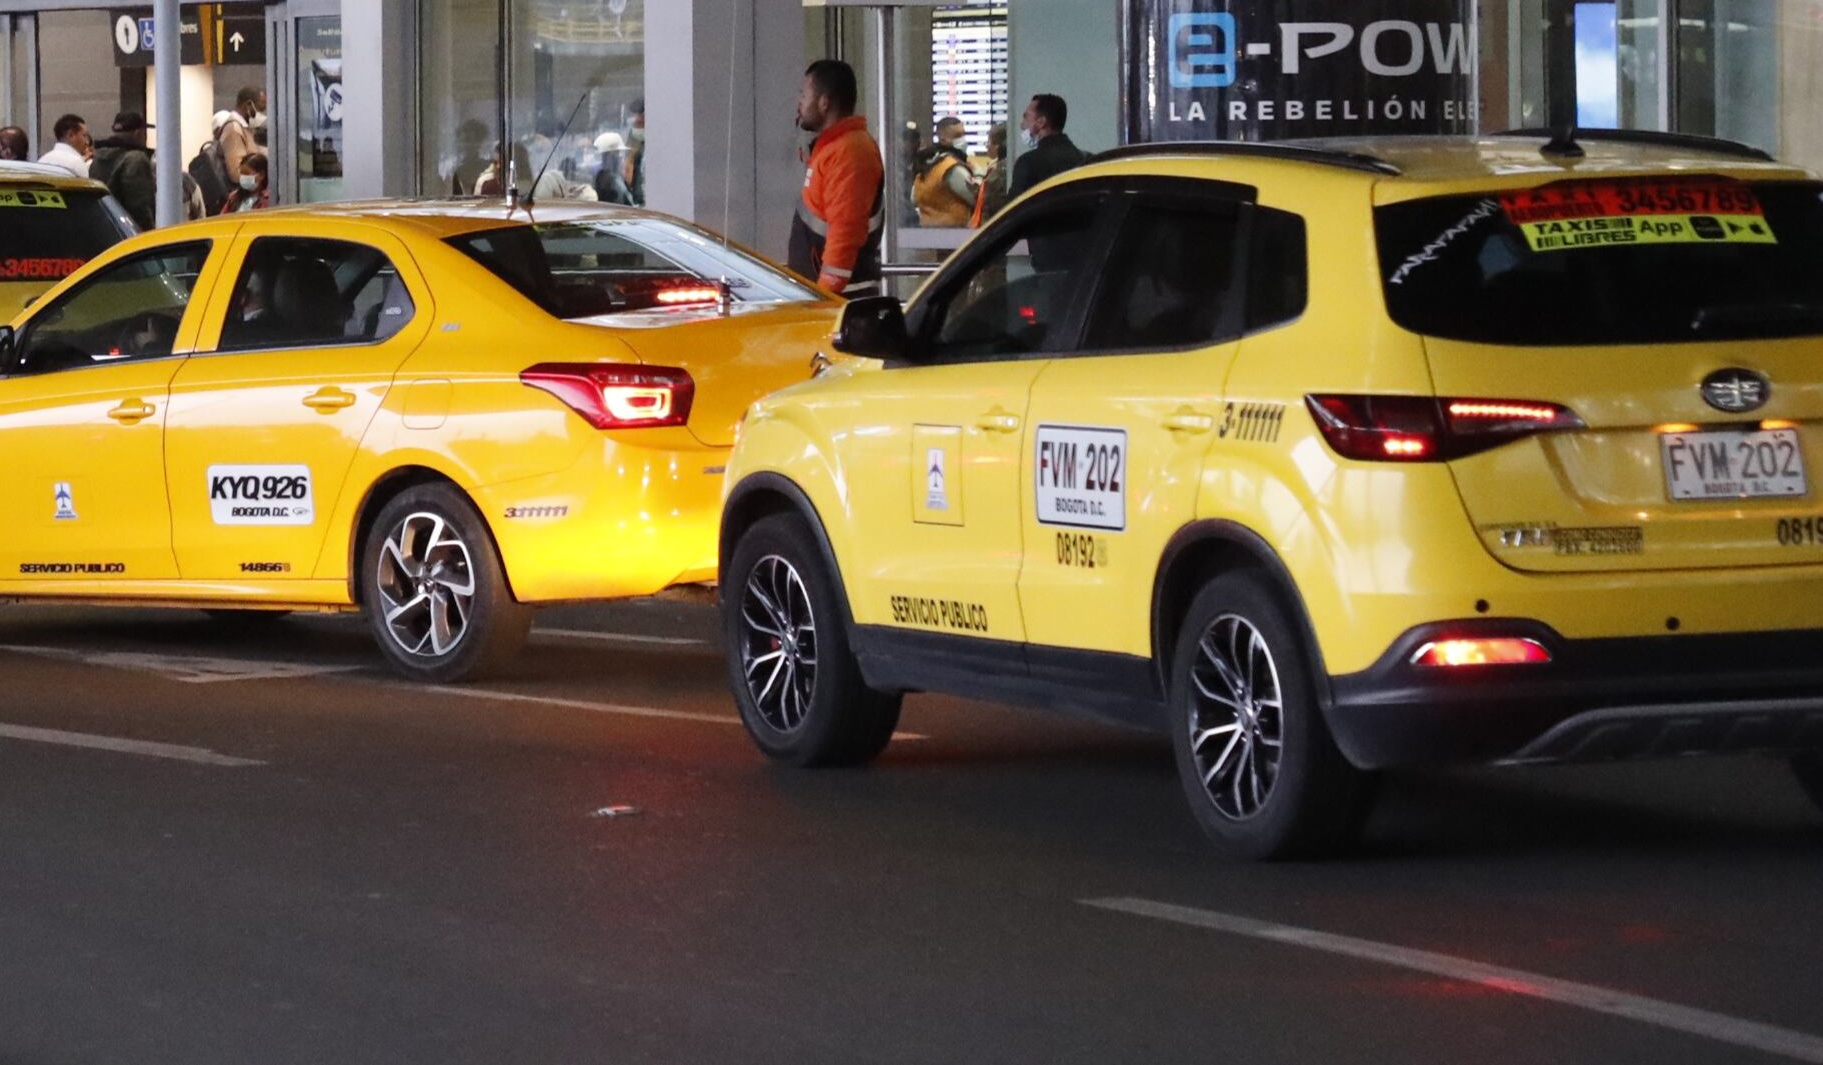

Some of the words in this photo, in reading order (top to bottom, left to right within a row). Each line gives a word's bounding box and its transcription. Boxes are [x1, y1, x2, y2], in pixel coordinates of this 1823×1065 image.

[1168, 101, 1206, 122] LA
[1228, 94, 1426, 122] REBELIÓN
[1617, 190, 1755, 213] 3456789
[1535, 218, 1608, 234] TAXIS
[1561, 230, 1637, 246] LIBRES
[1640, 220, 1683, 237] App
[1039, 440, 1077, 488] FVM
[1084, 443, 1121, 493] 202
[1668, 440, 1731, 482] FVM
[1737, 439, 1801, 478] 202
[231, 506, 271, 518] BOGOTA
[1056, 497, 1088, 515] BOGOTA
[1056, 532, 1096, 569] 08192
[19, 562, 72, 574] SERVICIO
[74, 562, 125, 574] PUBLICO
[890, 594, 940, 627] SERVICIO
[940, 599, 988, 632] PUBLICO
